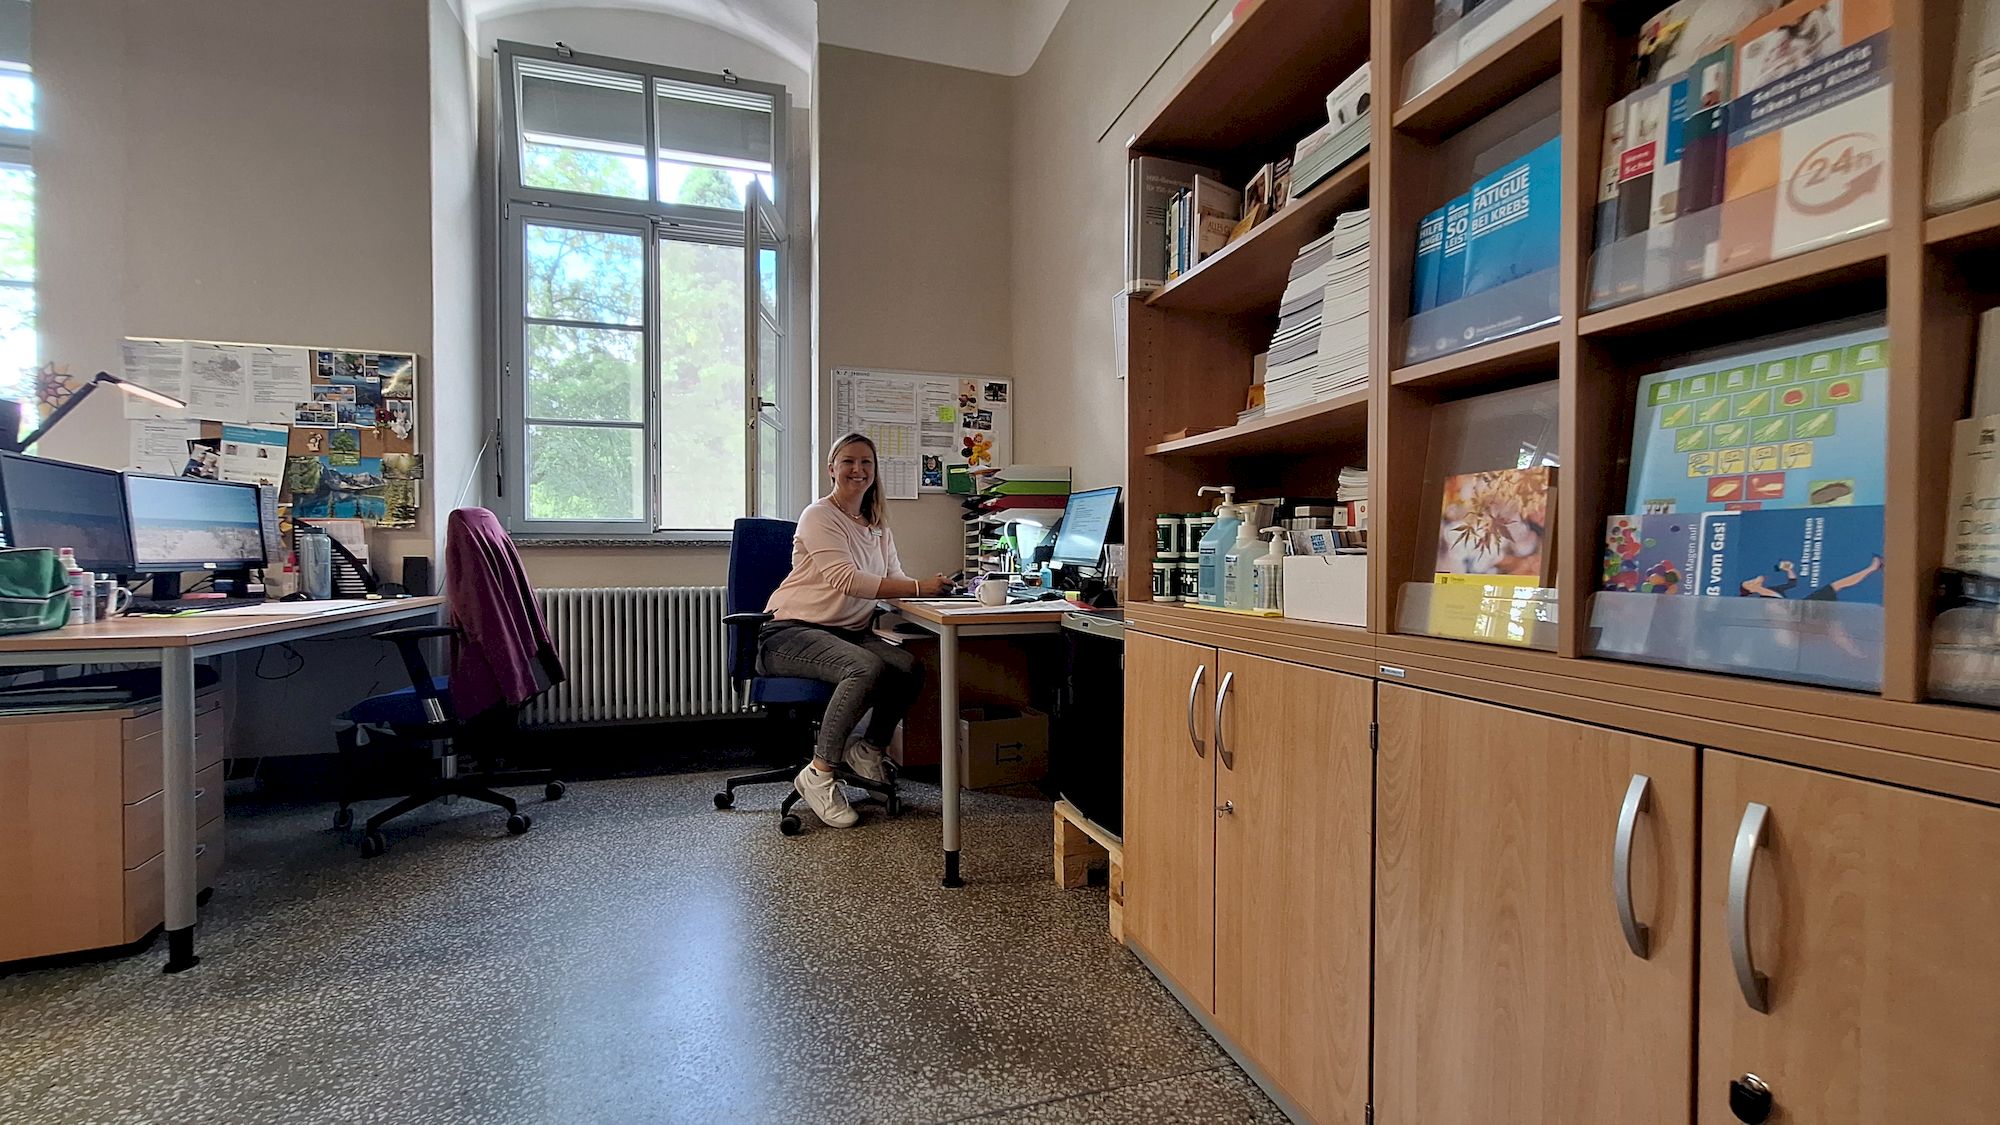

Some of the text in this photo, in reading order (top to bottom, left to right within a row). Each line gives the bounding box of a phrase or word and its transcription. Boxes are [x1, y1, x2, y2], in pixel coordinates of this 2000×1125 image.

[1472, 171, 1530, 213] FATIGUE
[1471, 213, 1489, 232] BEI
[1491, 195, 1530, 222] KREBS
[1419, 221, 1444, 239] HILFE
[1446, 218, 1468, 239] SO
[1688, 524, 1698, 541] auf!
[1711, 522, 1727, 551] Gas!
[1685, 543, 1697, 572] Magen
[1710, 554, 1724, 583] vom
[1685, 575, 1693, 587] den
